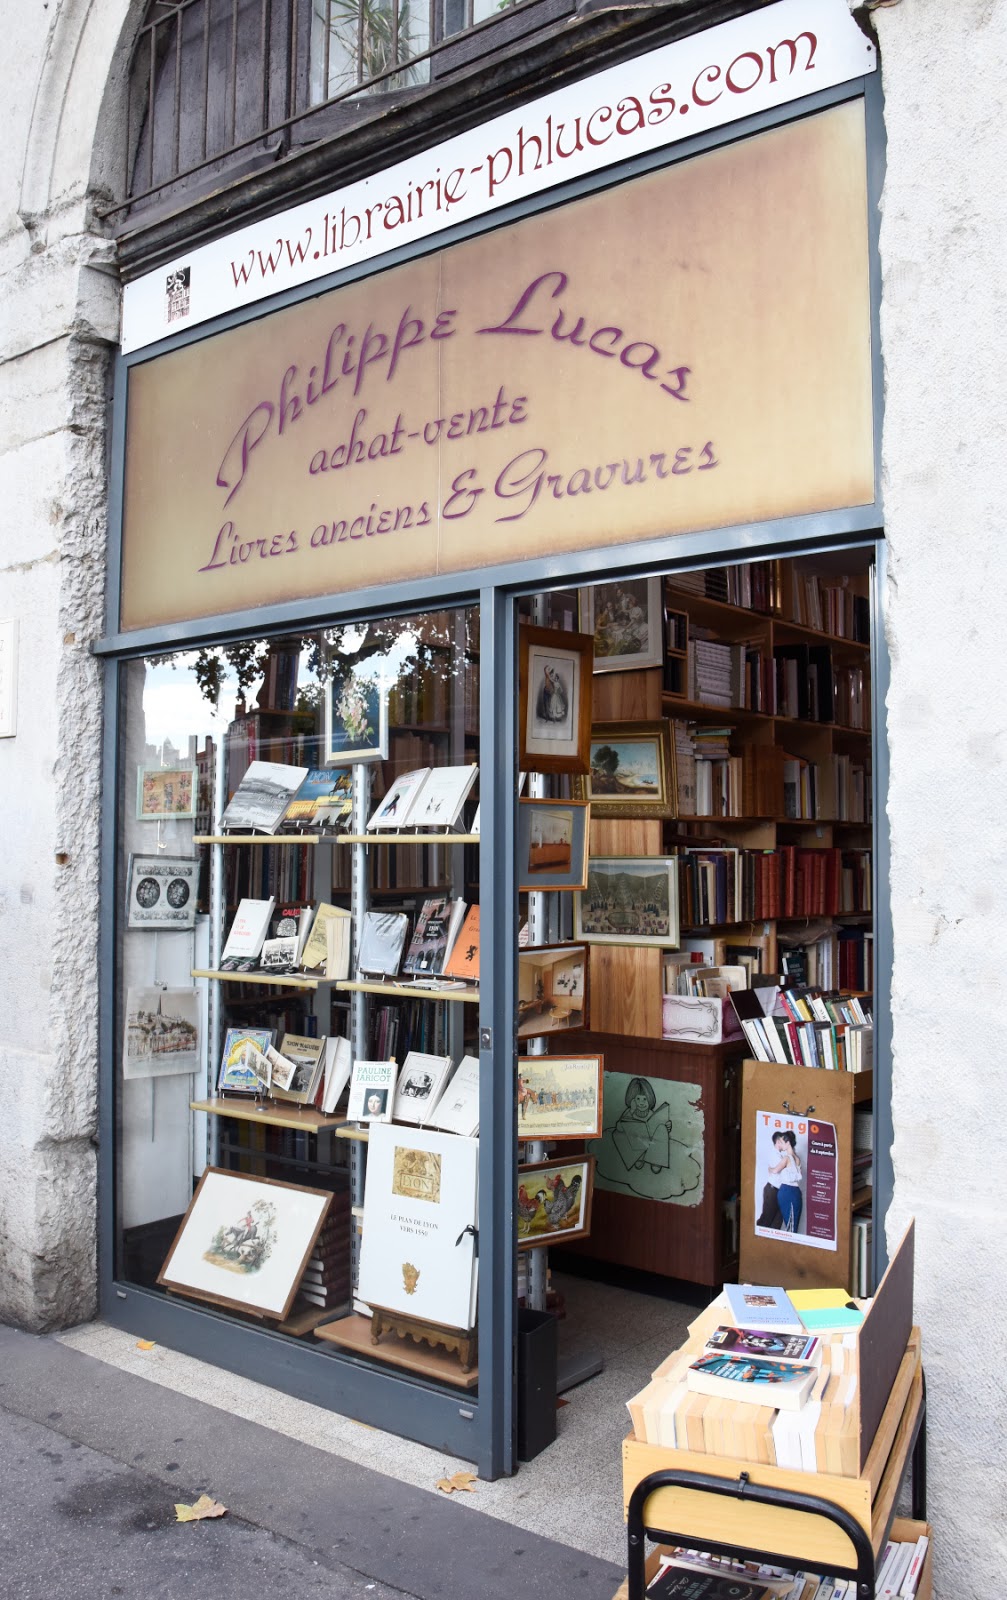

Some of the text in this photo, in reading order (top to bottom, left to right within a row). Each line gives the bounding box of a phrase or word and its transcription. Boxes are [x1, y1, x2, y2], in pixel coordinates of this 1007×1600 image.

[230, 31, 819, 290] www.librairie-phlucas.com
[215, 270, 694, 508] Philippe Lucas
[308, 386, 529, 477] achat-vente
[197, 439, 722, 573] Livres anciens & Gravures
[355, 1074, 391, 1083] JARICOT
[357, 1066, 392, 1075] PAULINE
[762, 1114, 820, 1134] Tango
[402, 1175, 430, 1190] LYON
[398, 1214, 413, 1224] PLAN
[413, 1218, 421, 1227] DE
[422, 1220, 439, 1230] LYON
[400, 1225, 414, 1234] VERS
